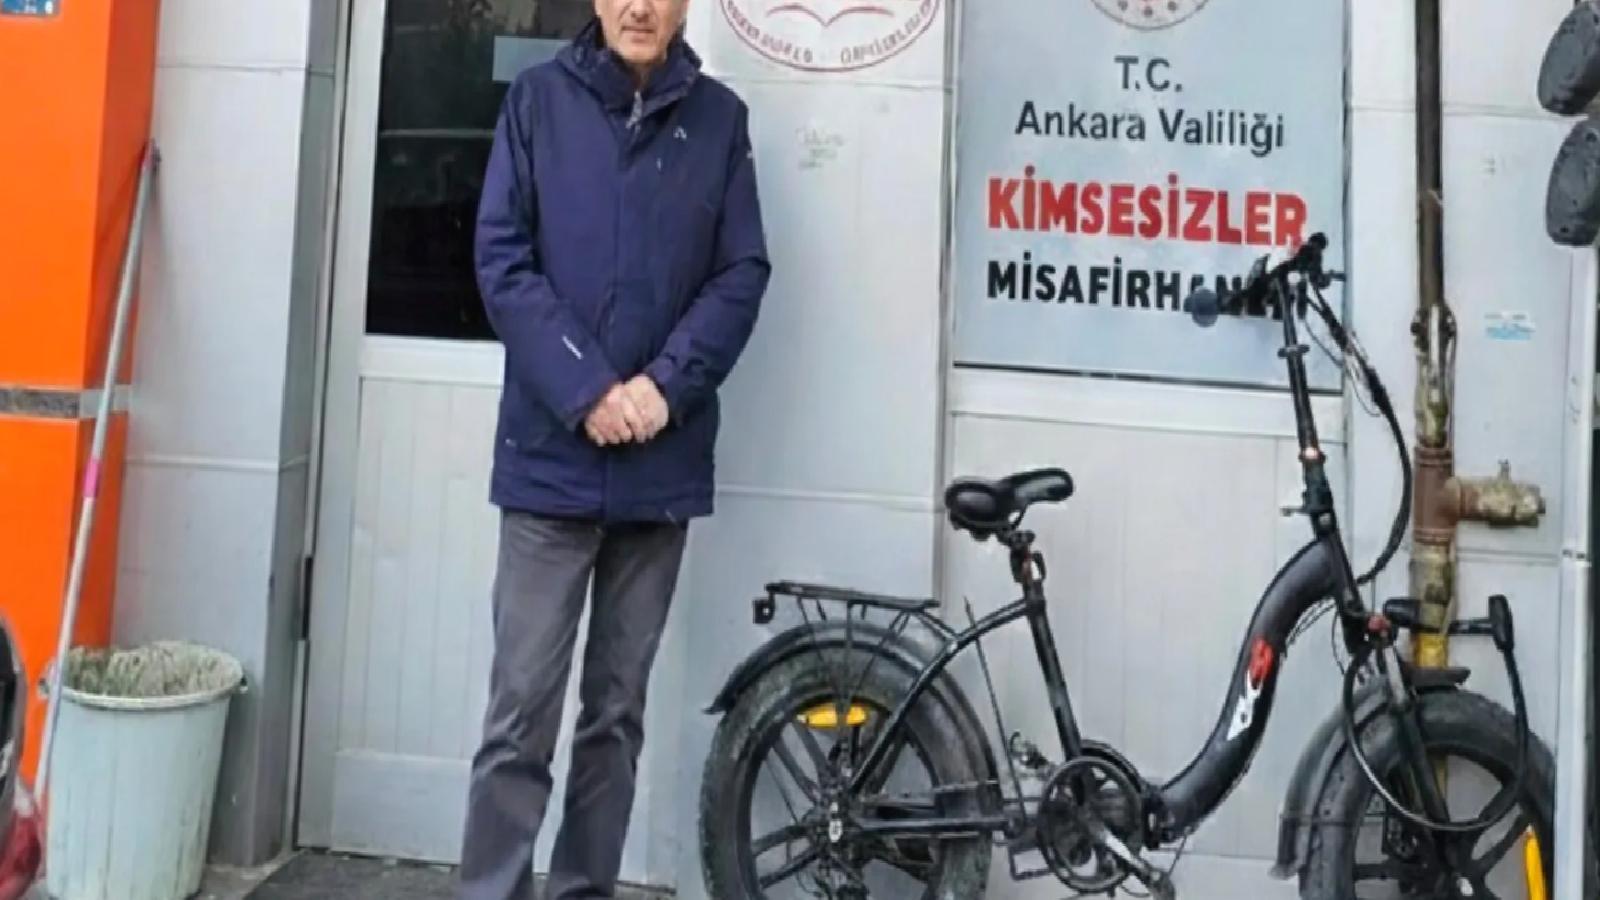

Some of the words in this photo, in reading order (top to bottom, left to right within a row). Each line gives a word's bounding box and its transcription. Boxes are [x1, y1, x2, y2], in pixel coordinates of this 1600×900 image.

[1114, 55, 1183, 92] T.C.
[1015, 101, 1146, 142] Ankara
[1159, 108, 1284, 158] Valiliği
[987, 165, 1307, 249] KİMSESİZLER
[987, 251, 1270, 318] MİSAFİRHAN
